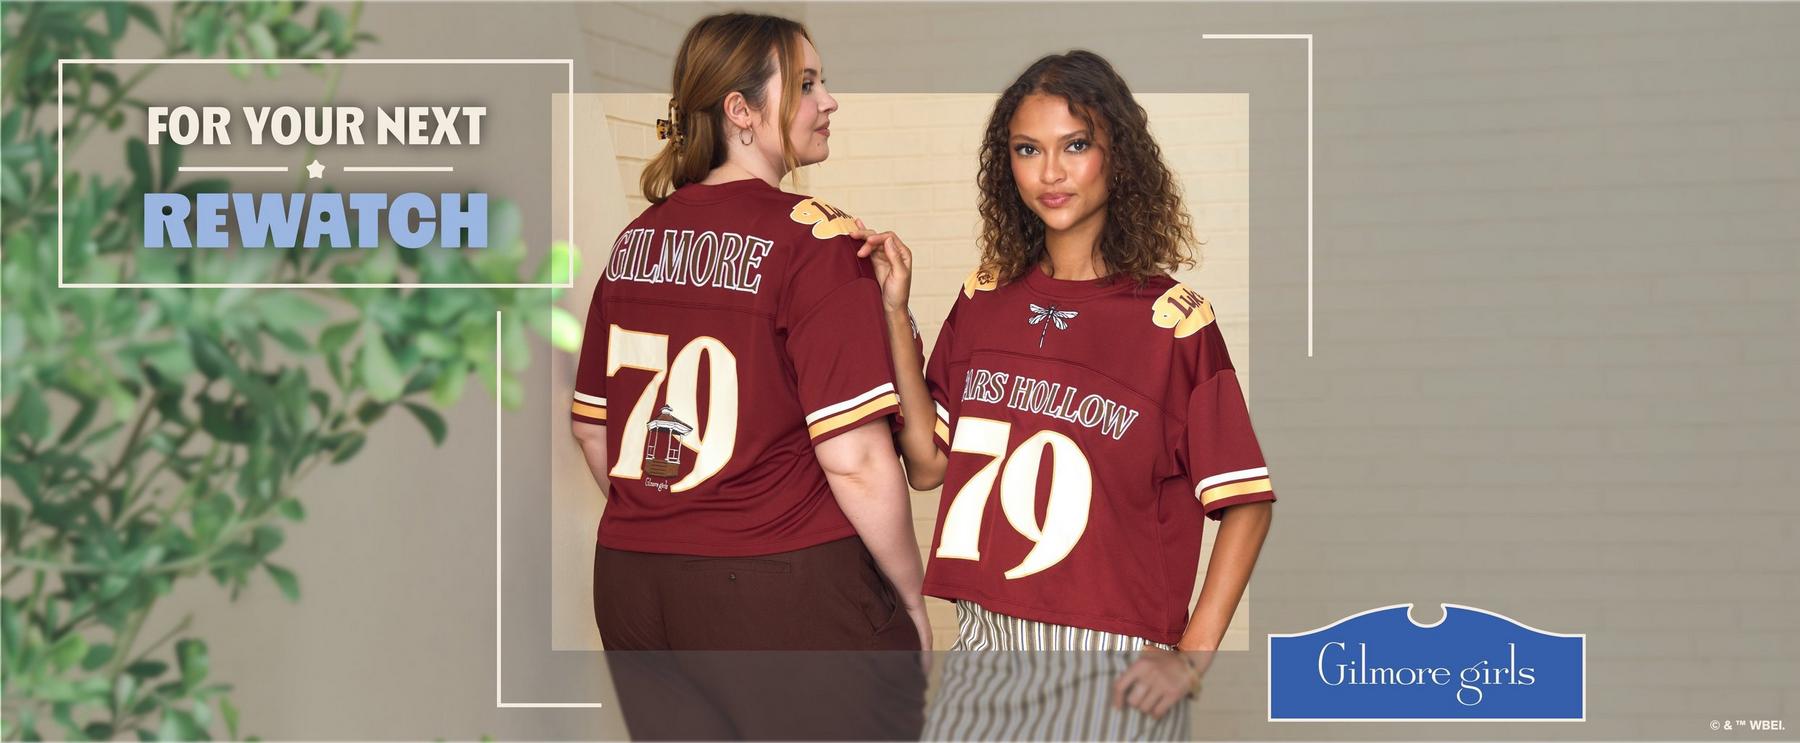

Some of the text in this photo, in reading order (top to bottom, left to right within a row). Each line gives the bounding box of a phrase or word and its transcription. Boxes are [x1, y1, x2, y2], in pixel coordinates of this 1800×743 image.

[605, 228, 774, 294] GILMORE
[606, 323, 739, 493] 79
[961, 368, 1139, 440] ARS HOLLOW
[935, 416, 1093, 580] 79
